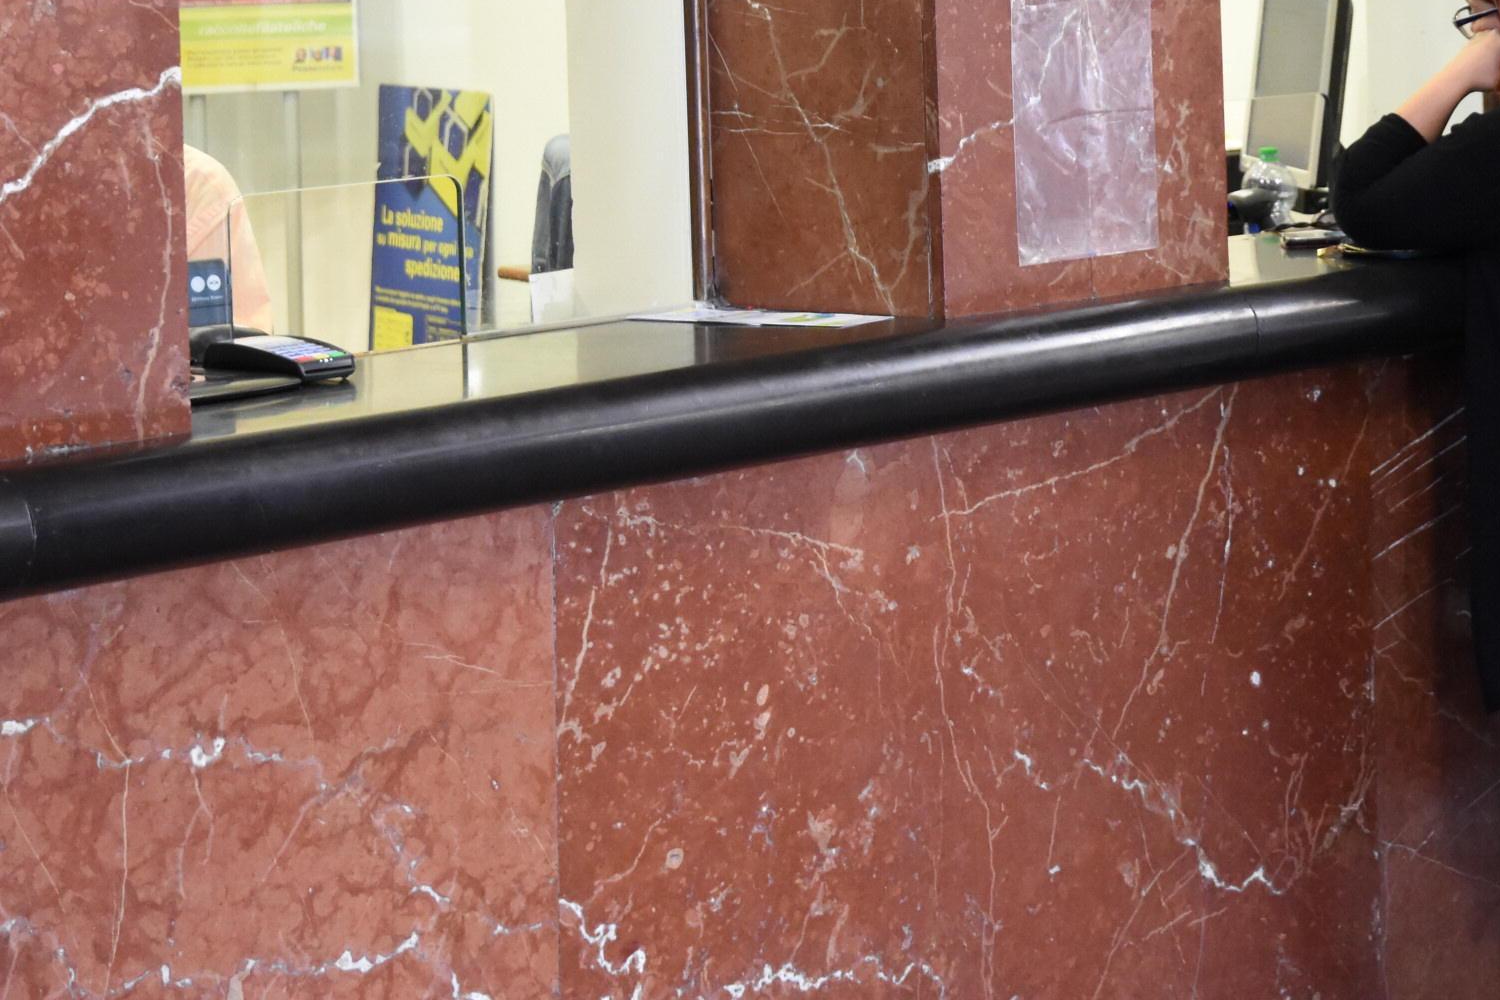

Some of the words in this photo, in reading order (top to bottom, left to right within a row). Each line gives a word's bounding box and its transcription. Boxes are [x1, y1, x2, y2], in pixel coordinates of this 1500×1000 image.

[381, 204, 394, 225] La
[395, 207, 444, 233] soluzione
[387, 229, 422, 251] misura
[405, 257, 460, 282] spedizione
